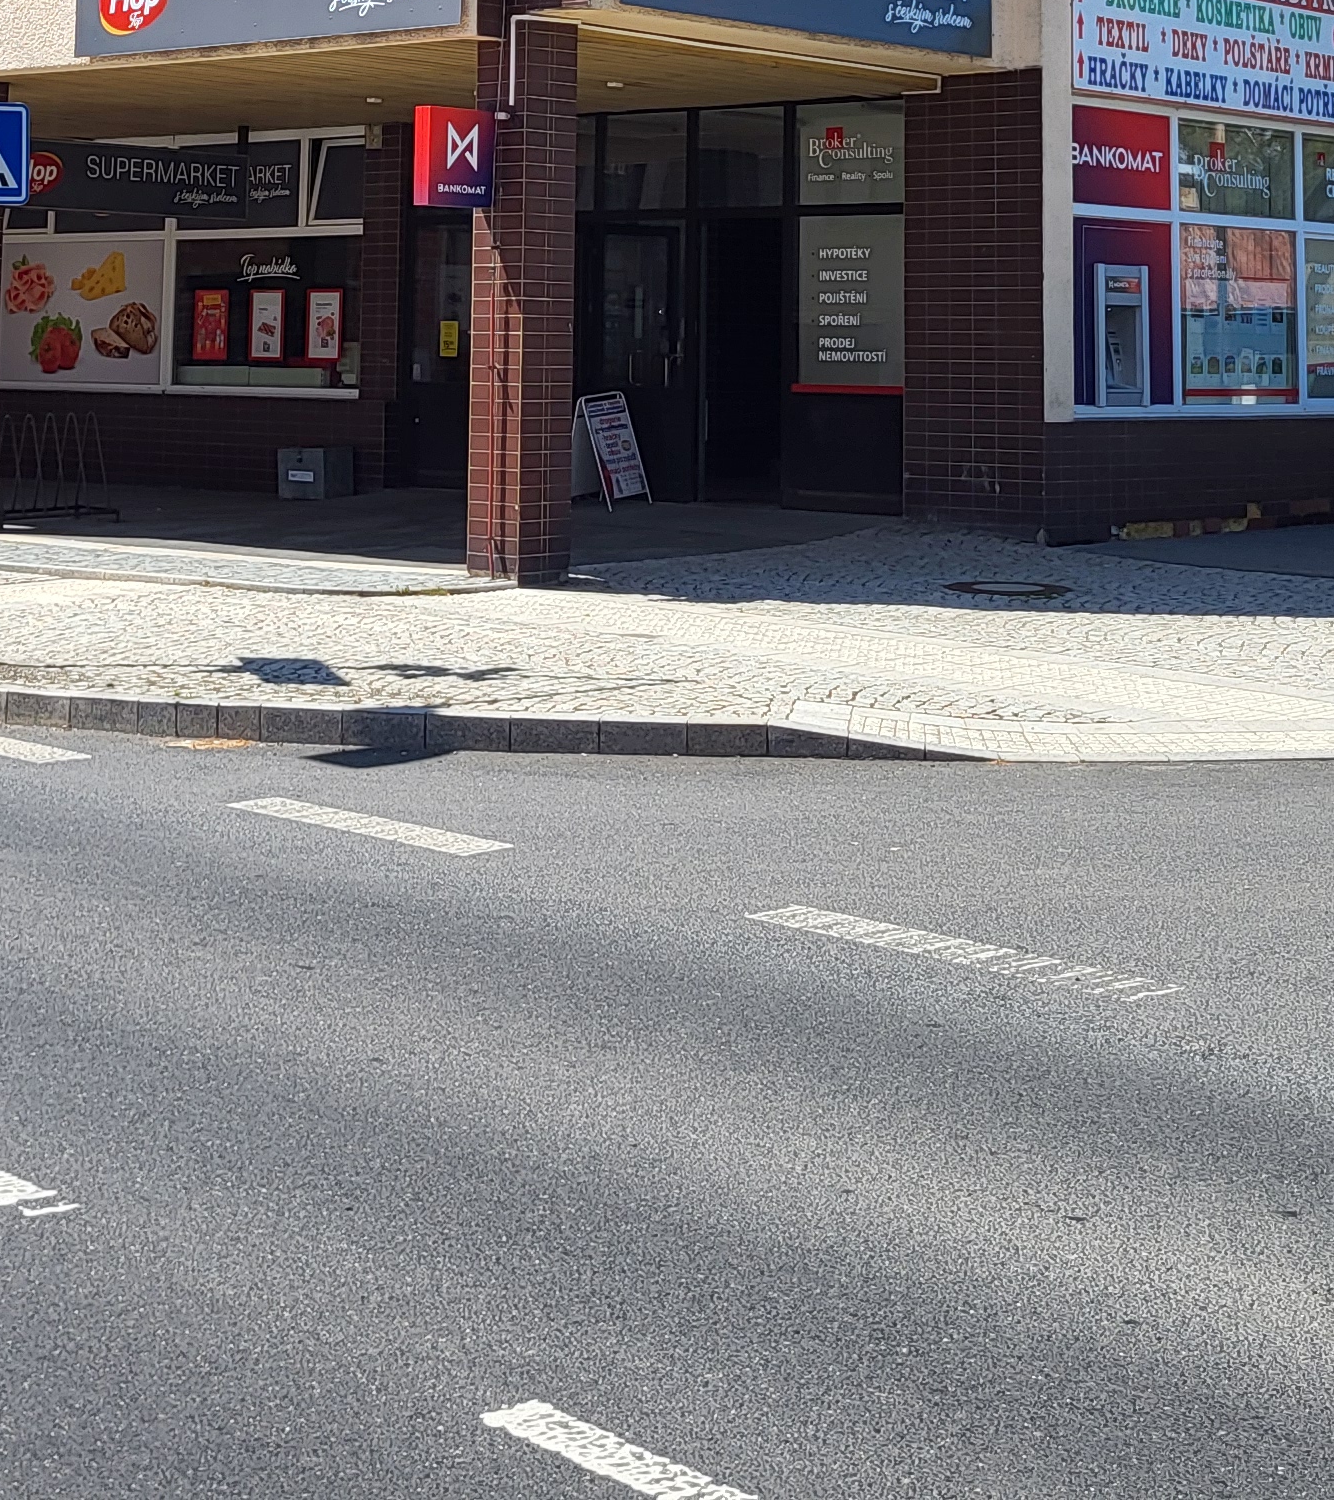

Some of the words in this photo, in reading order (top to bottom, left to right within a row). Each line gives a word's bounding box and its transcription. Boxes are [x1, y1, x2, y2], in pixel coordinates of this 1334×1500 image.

[885, 3, 895, 22] s
[933, 3, 973, 29] srdcem
[1288, 11, 1322, 44] OBUV
[1096, 14, 1150, 53] TEXTIL
[1171, 28, 1208, 62] DEKY
[1087, 51, 1149, 93] HRAČKY
[1164, 66, 1228, 104] KABELKY
[1242, 74, 1294, 113] DOMÁCÍ
[809, 132, 857, 157] Broker
[819, 141, 894, 169] Consulting
[1071, 142, 1164, 173] BANKOMAT
[1192, 149, 1238, 181] Broker
[29, 160, 58, 185] lop
[86, 154, 241, 189] SUPERMARKET
[808, 173, 835, 182] Finance
[841, 171, 867, 182] Reality
[873, 170, 894, 181] Spolu
[1204, 167, 1271, 199] Consulting
[437, 183, 486, 195] BANKOMAT
[819, 246, 871, 259] HYPOTÉKY
[240, 254, 258, 282] Top
[259, 256, 298, 274] nabídka
[819, 270, 868, 281] INVESTICE
[819, 290, 867, 304] POJIŠTĚNÍ
[819, 313, 861, 326] SPOŘENÍ
[818, 337, 855, 348] PRODEJ
[818, 349, 886, 362] NEMOVITOSTÍ
